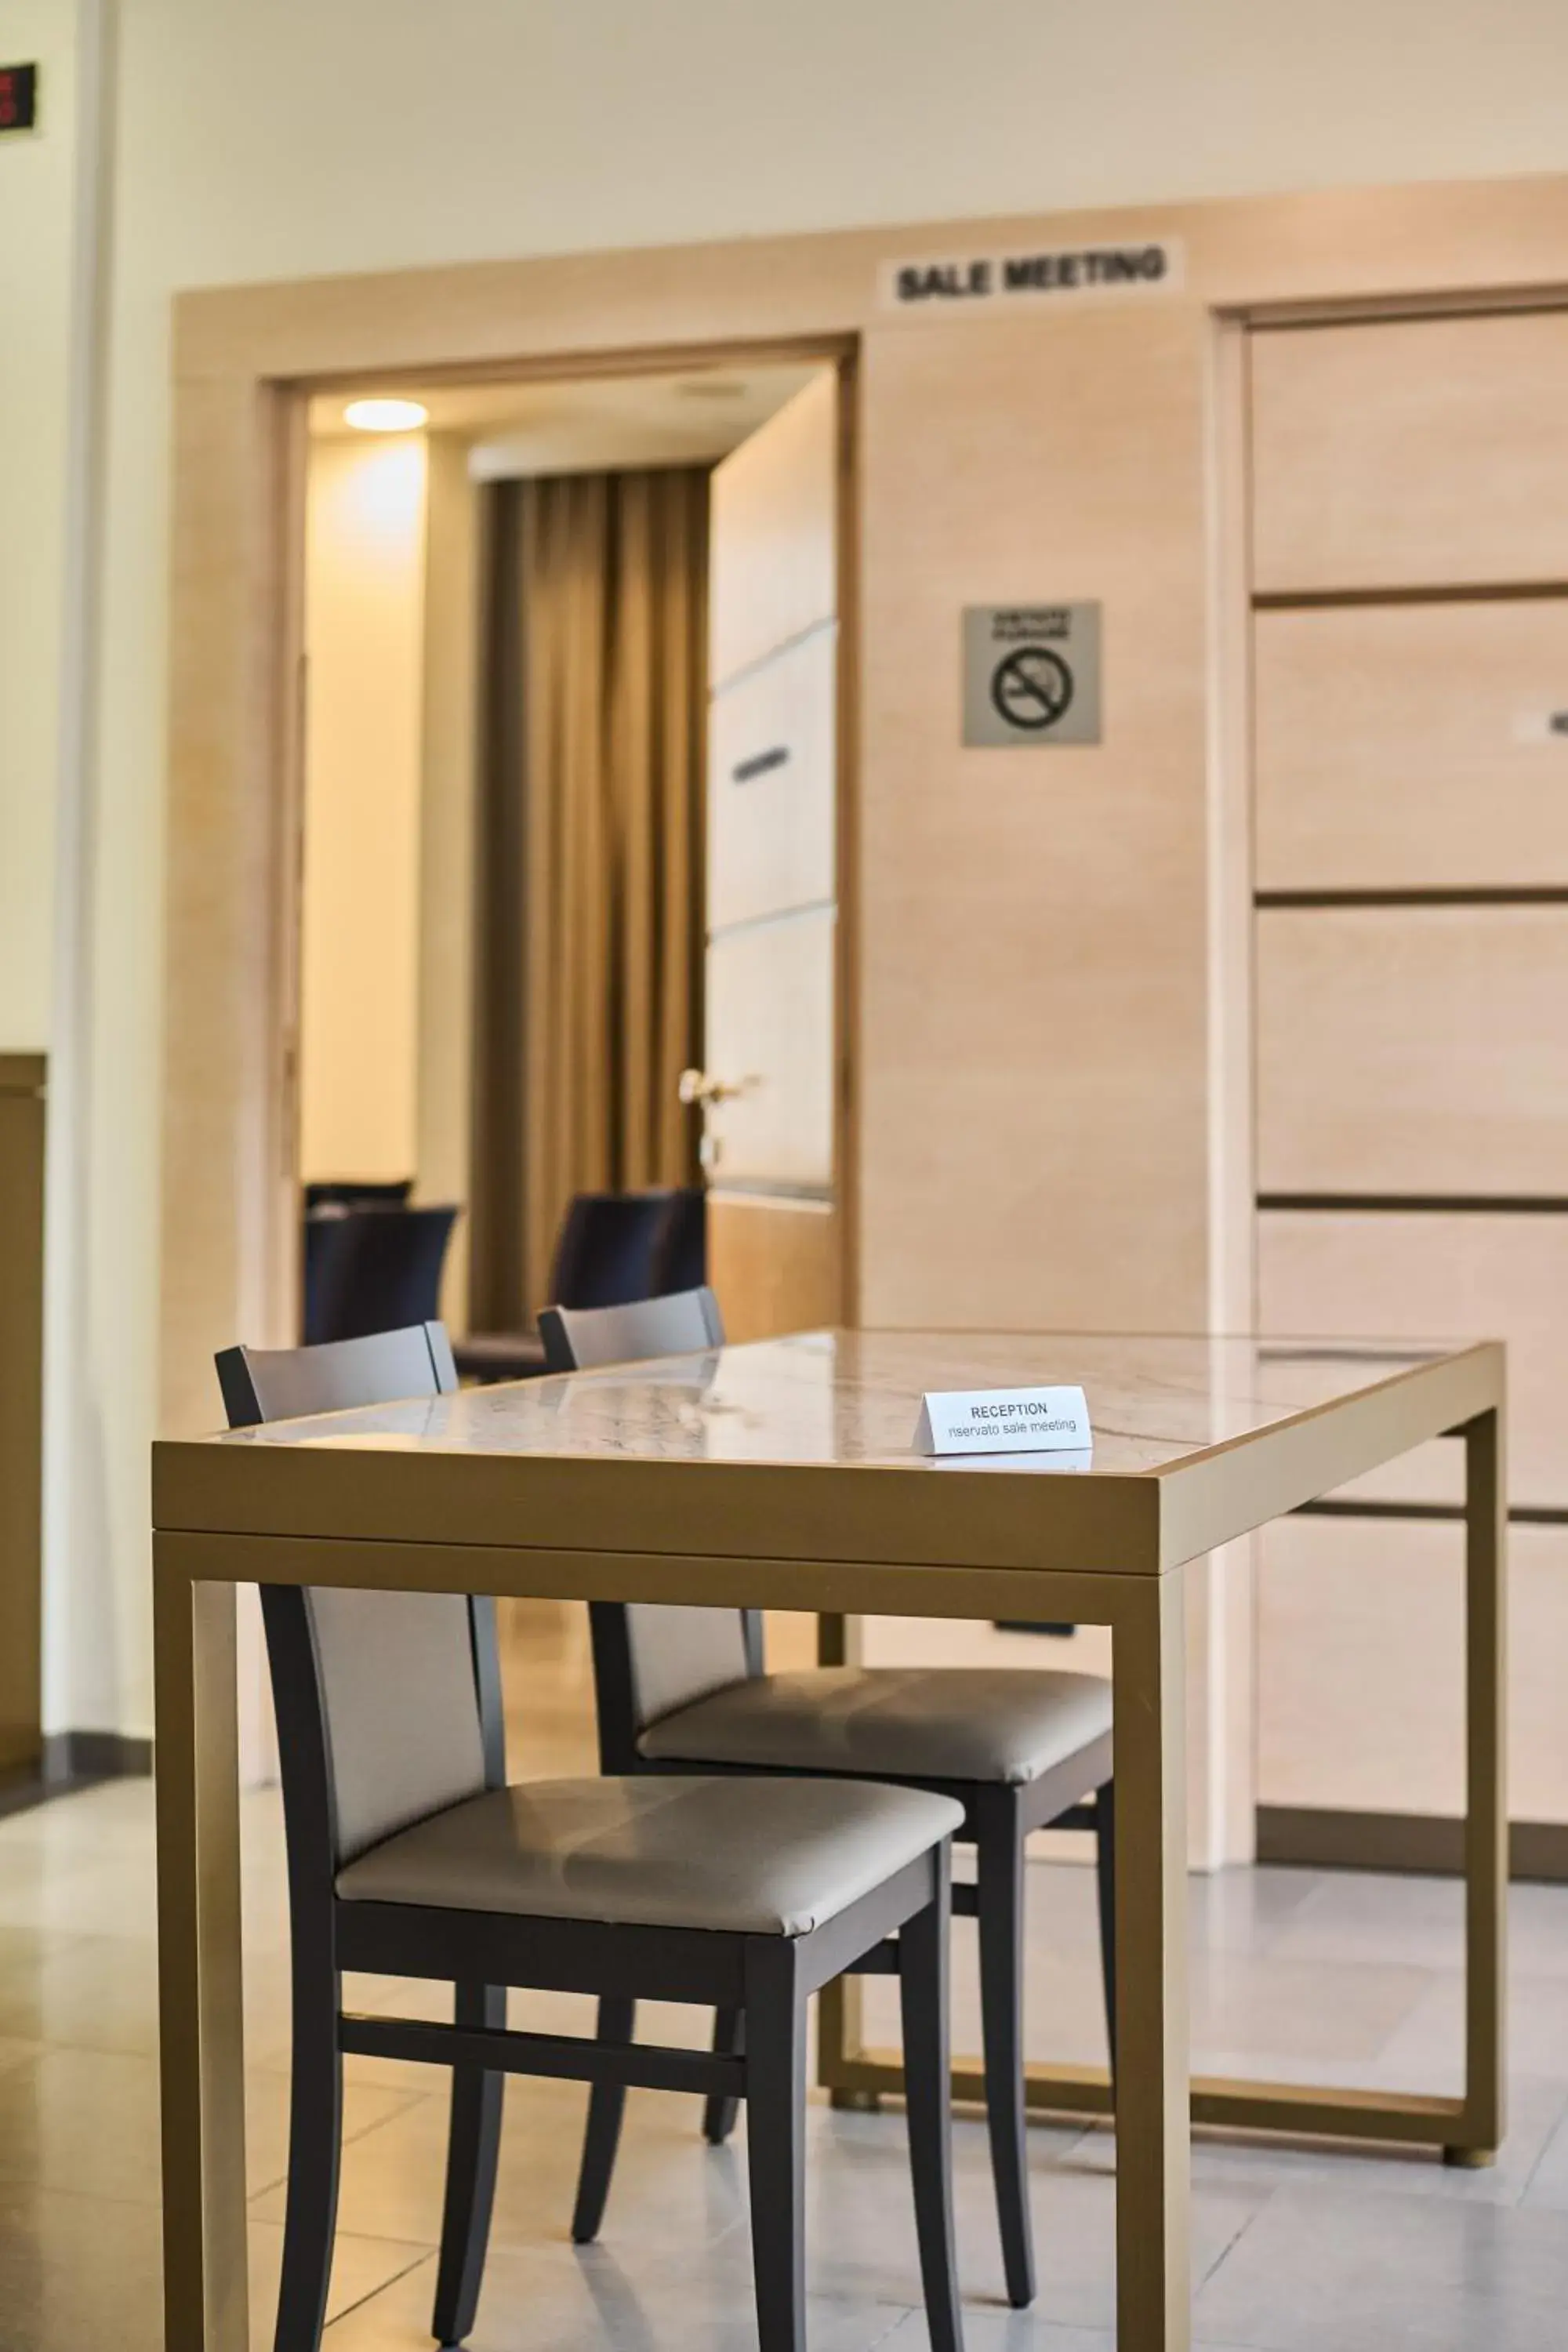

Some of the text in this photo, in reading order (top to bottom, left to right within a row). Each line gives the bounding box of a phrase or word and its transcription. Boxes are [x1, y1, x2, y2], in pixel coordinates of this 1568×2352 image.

[898, 245, 1166, 299] SALE MEETING
[971, 1403, 1047, 1418] RECEPTION
[949, 1419, 1076, 1438] riservato sale meeting
